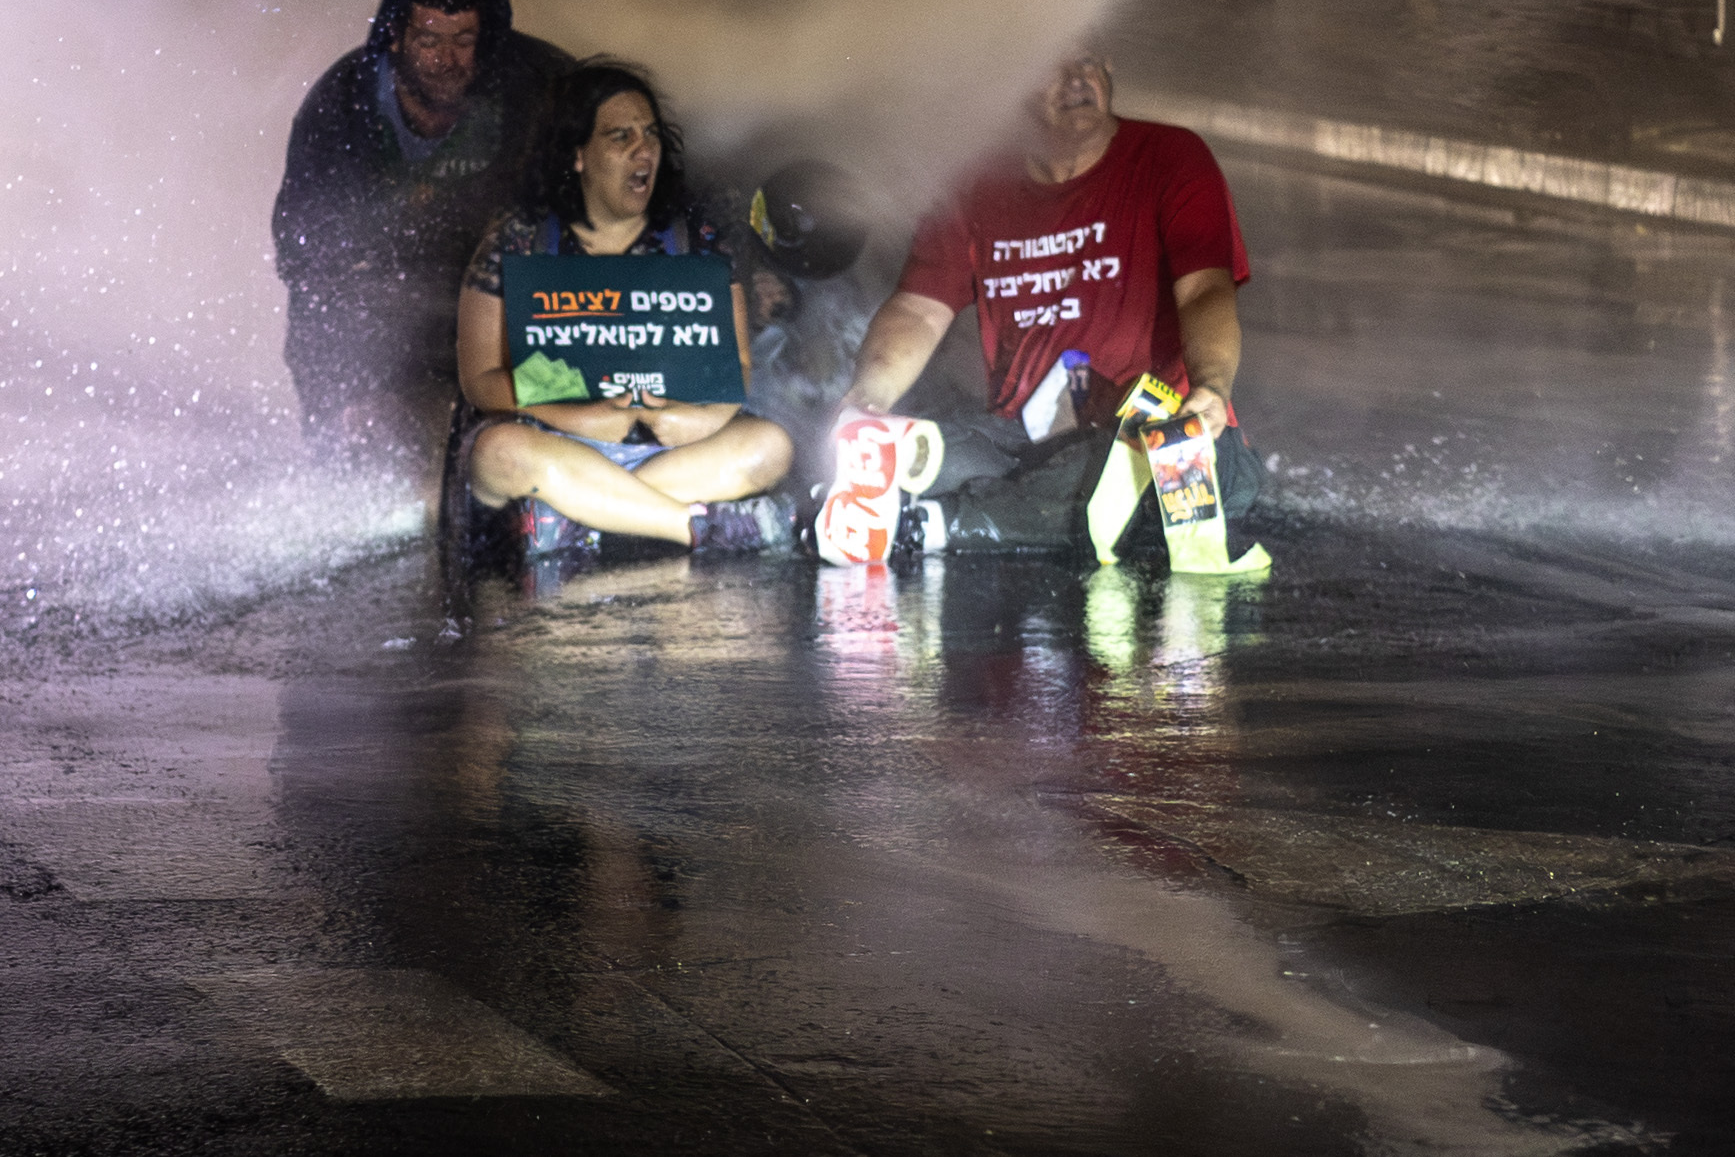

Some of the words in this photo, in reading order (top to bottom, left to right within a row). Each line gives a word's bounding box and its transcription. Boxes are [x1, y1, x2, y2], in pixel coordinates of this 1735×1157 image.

[1082, 256, 1120, 281] לא
[532, 289, 622, 311] לציבור
[630, 291, 714, 312] כספים
[525, 322, 664, 350] לקואליציה
[672, 323, 720, 346] ולא
